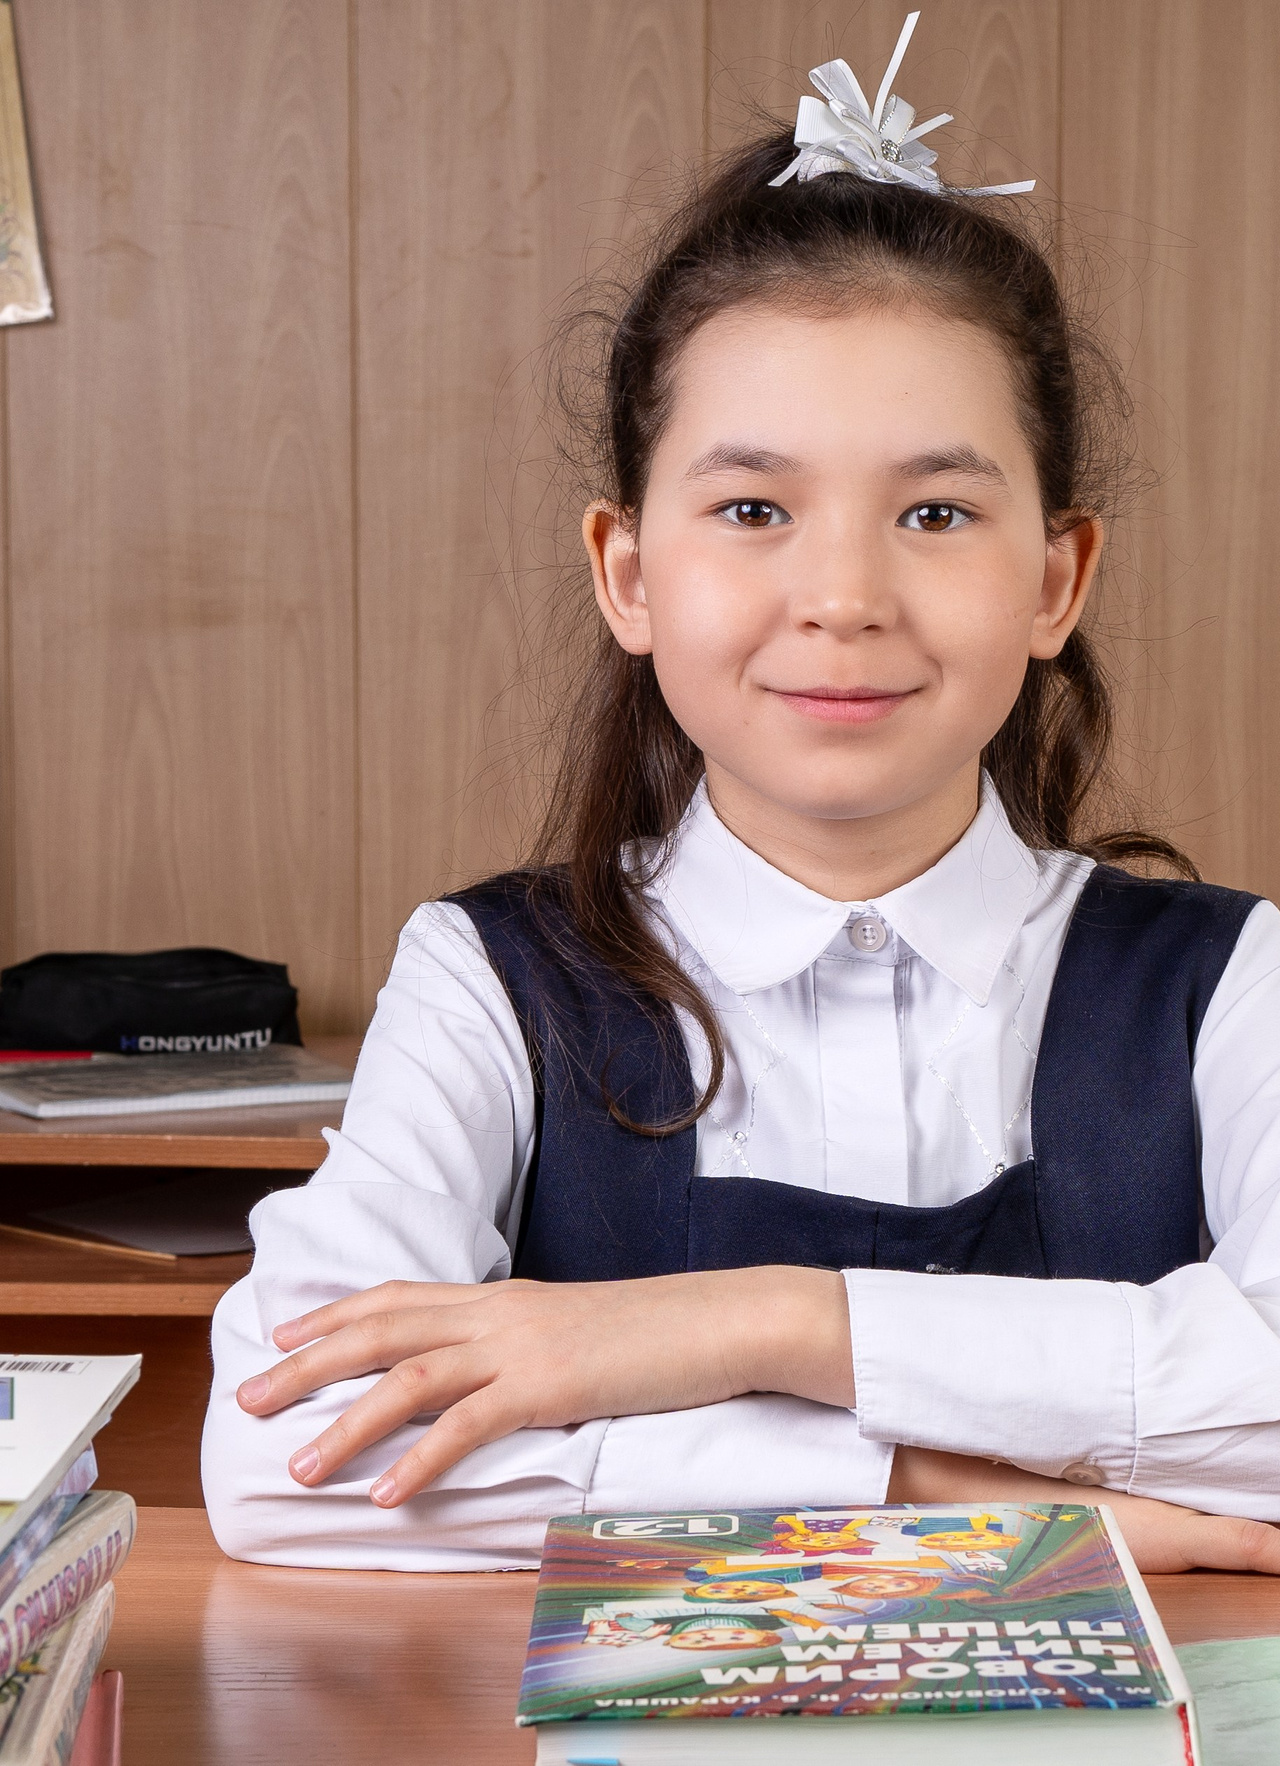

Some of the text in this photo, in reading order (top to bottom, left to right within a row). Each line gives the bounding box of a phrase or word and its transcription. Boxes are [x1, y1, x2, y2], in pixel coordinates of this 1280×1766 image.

[120, 1027, 272, 1052] HONGYUNTU
[613, 1518, 719, 1536] 1-2
[792, 1619, 1127, 1642] ПИШЕМ
[780, 1638, 1136, 1662] ЧИТАЕМ
[700, 1658, 1142, 1686] ГОВОРИМ
[595, 1695, 761, 1708] КАРАШЕВА
[851, 1686, 1067, 1702] ГОЛОВАНОВА,
